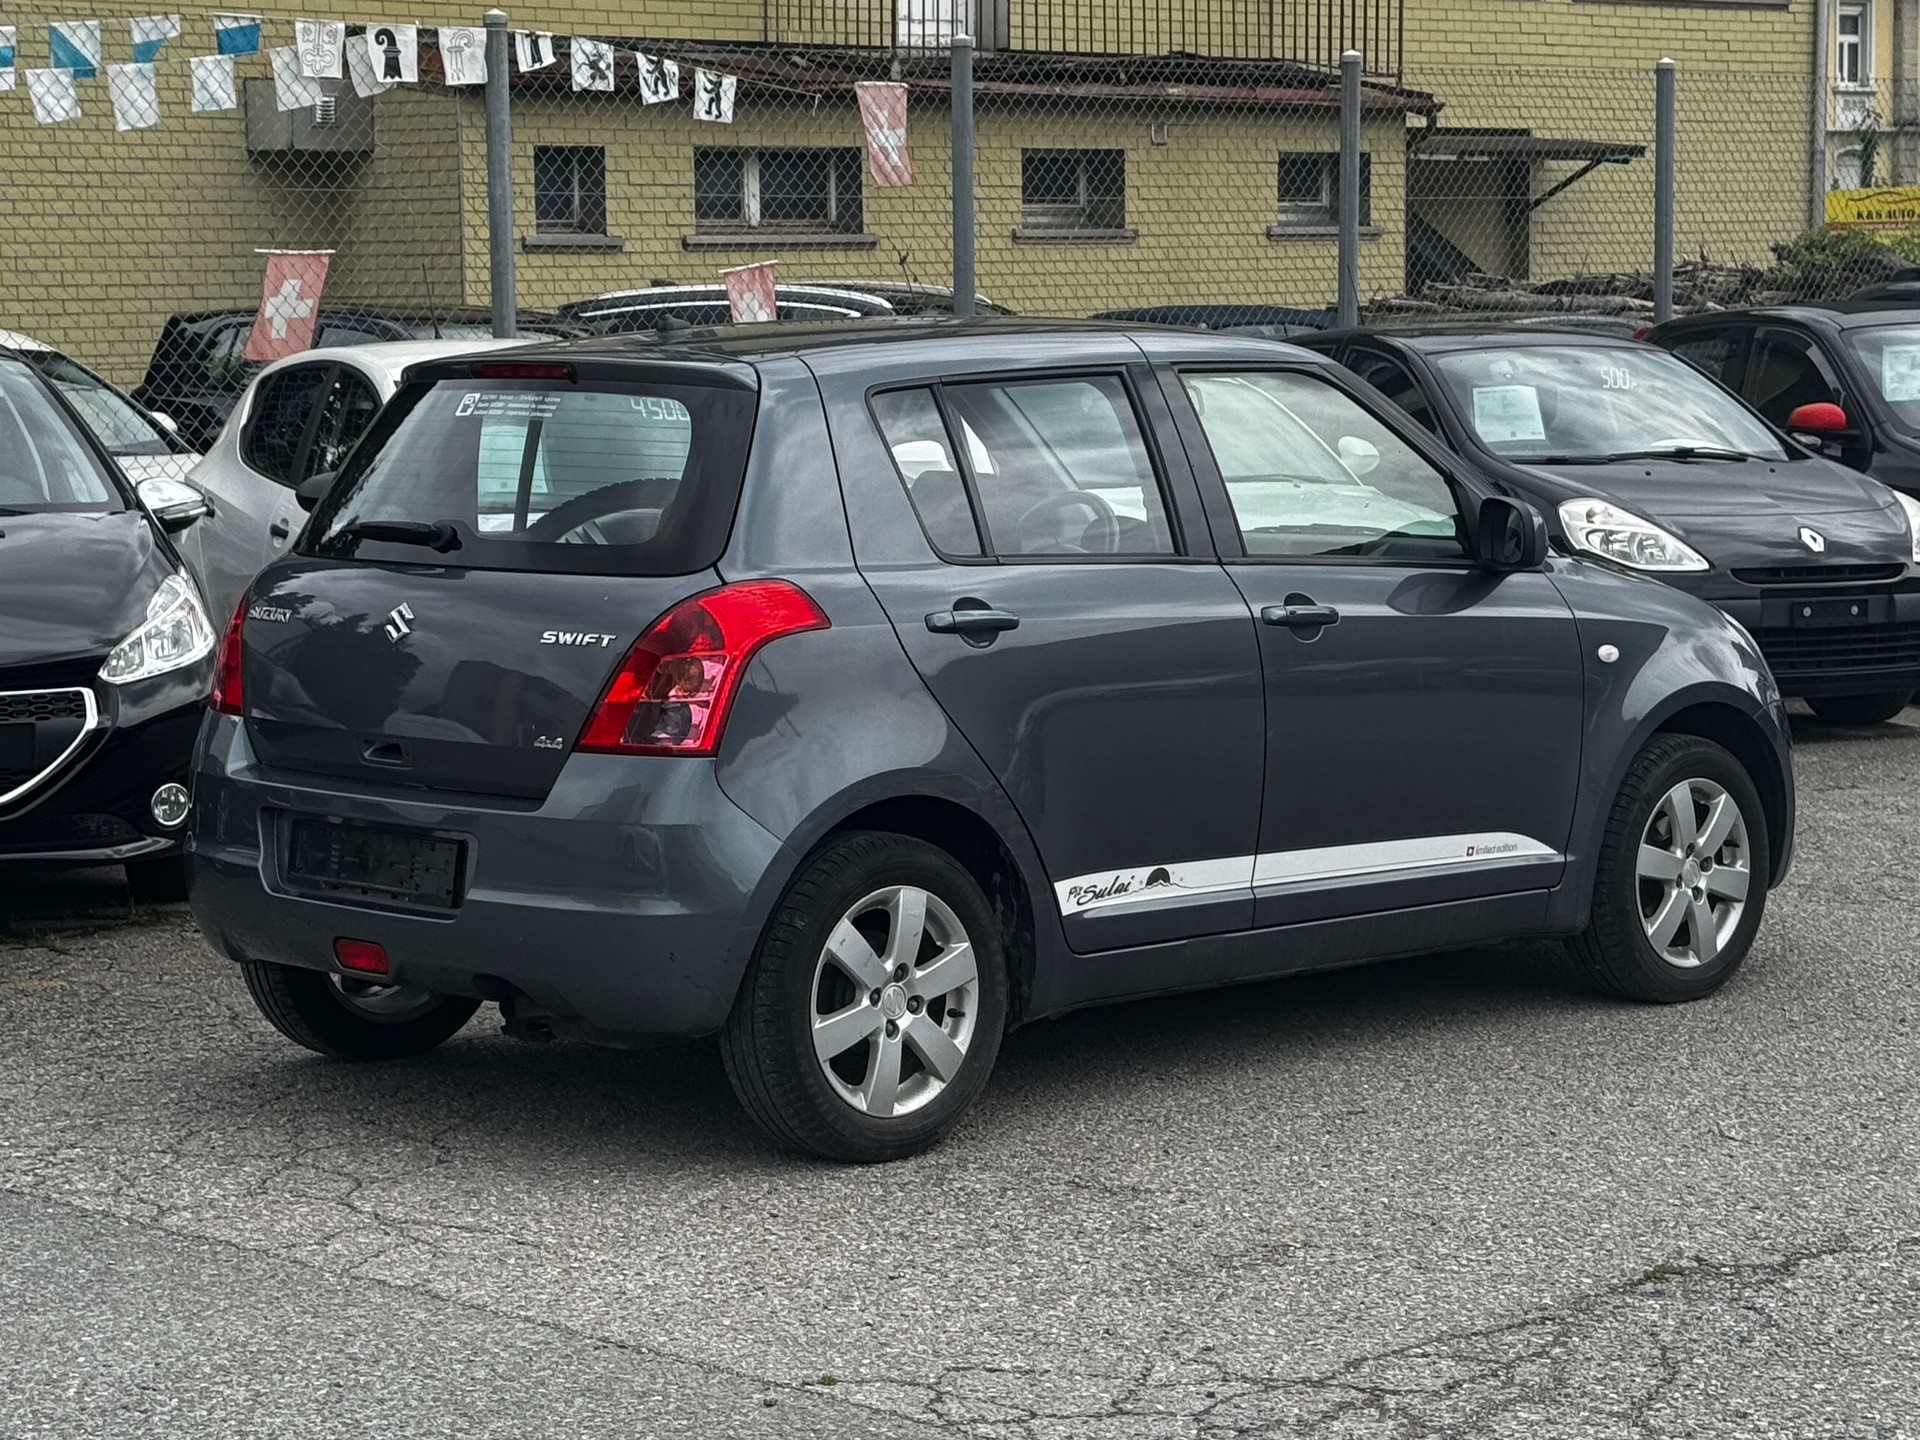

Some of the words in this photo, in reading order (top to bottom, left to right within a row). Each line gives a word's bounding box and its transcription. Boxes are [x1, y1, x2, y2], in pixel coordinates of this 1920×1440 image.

[1885, 208, 1915, 220] AUTO
[248, 605, 292, 622] SUZUKI
[540, 630, 616, 647] SWIFT
[533, 736, 563, 750] 4x4
[1076, 875, 1135, 906] Sulai
